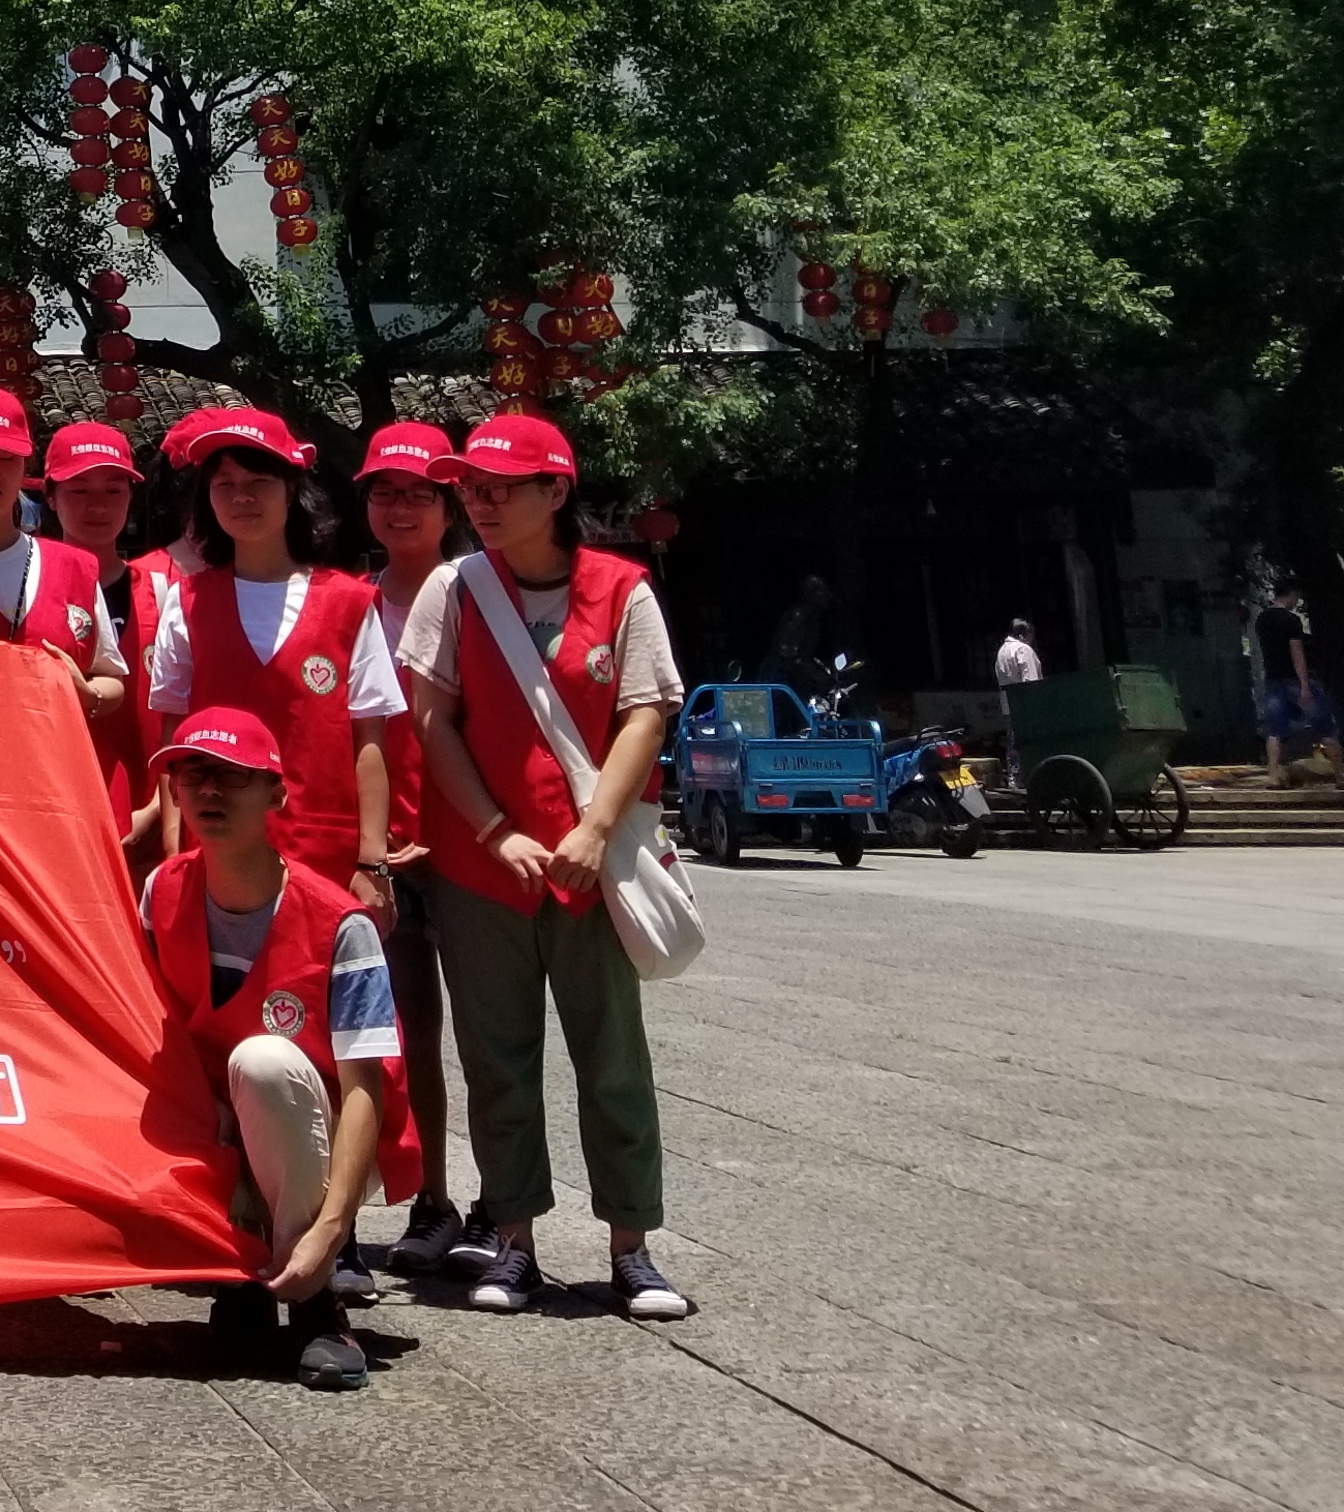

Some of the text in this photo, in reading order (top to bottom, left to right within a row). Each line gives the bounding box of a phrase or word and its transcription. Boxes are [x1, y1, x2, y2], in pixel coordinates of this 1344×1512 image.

[260, 98, 310, 237] 天天好日子
